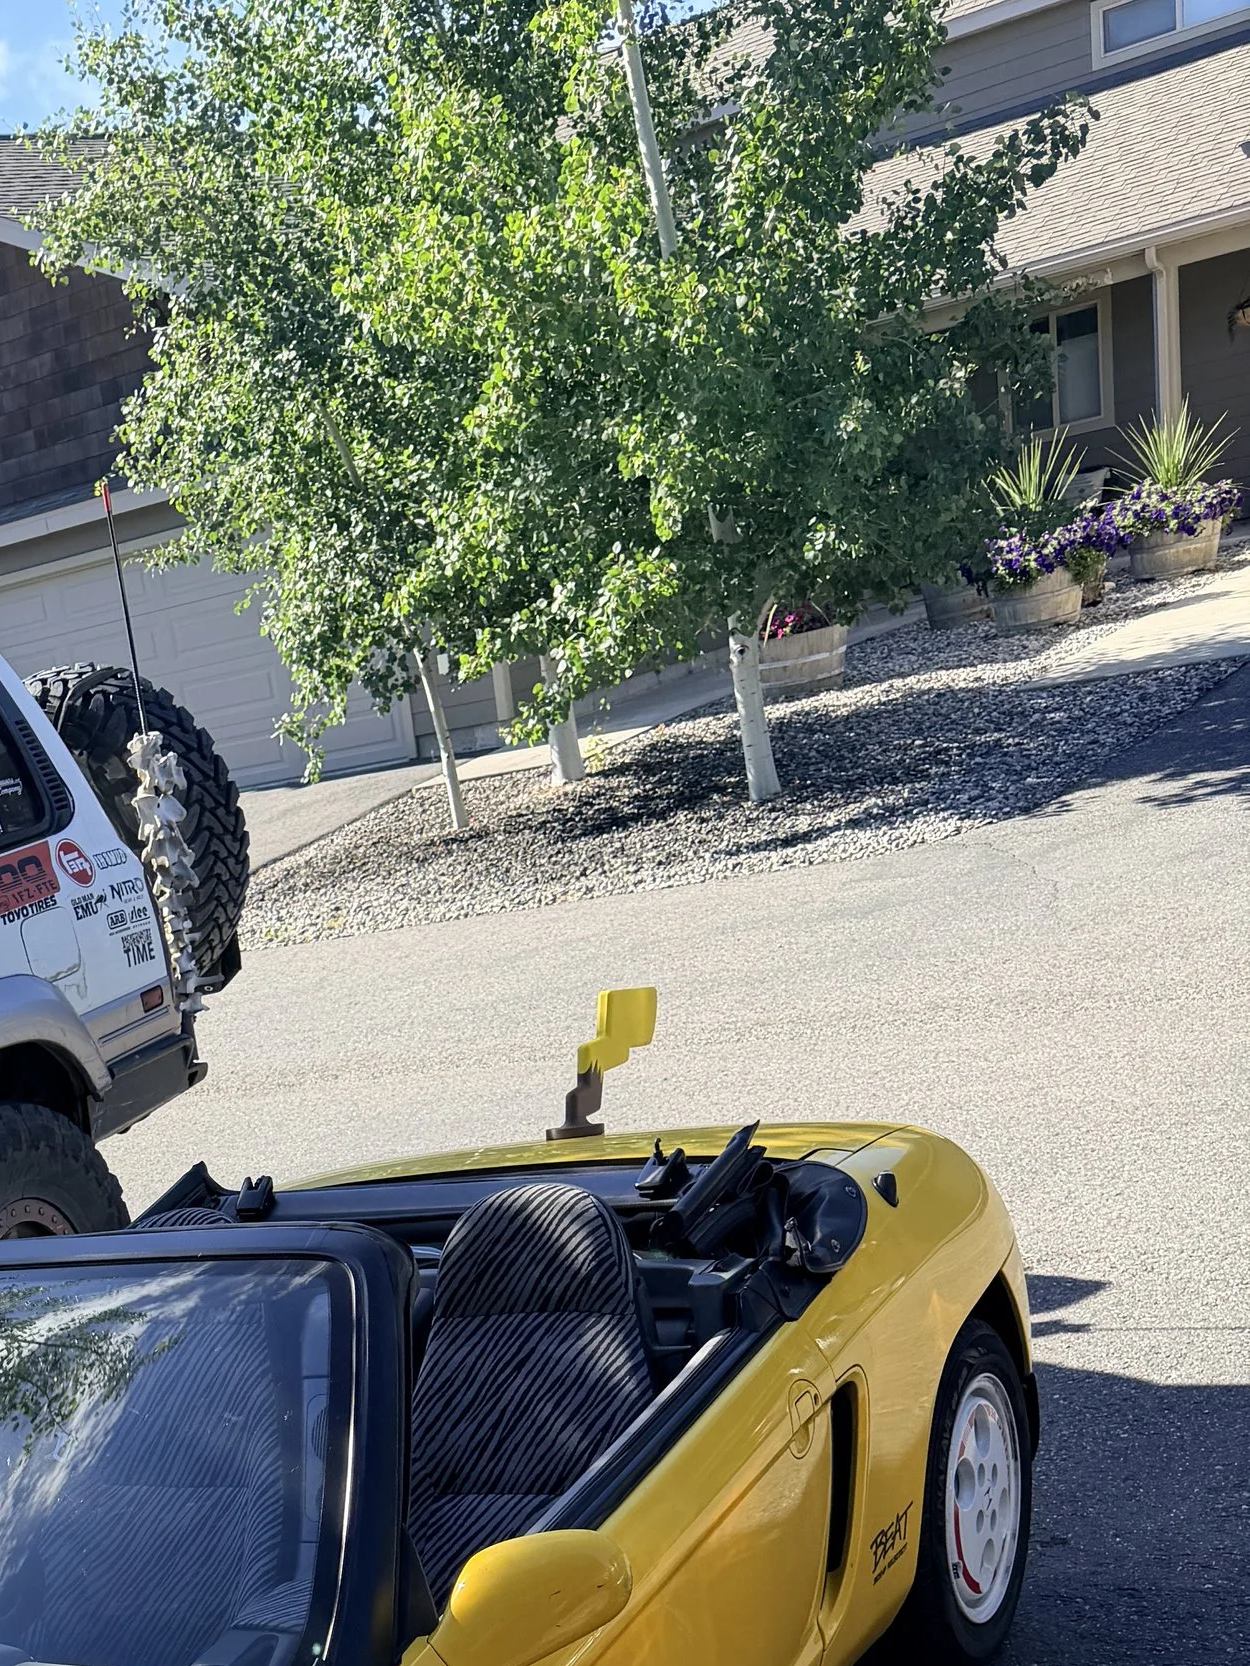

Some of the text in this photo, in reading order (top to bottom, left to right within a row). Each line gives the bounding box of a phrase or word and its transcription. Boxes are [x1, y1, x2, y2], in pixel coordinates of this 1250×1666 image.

[108, 878, 144, 903] NITRO
[0, 895, 57, 925] TOYO TIRES
[73, 900, 98, 921] EMU
[109, 912, 126, 927] ARB
[123, 941, 156, 968] TIME
[870, 1500, 914, 1574] BEAT
